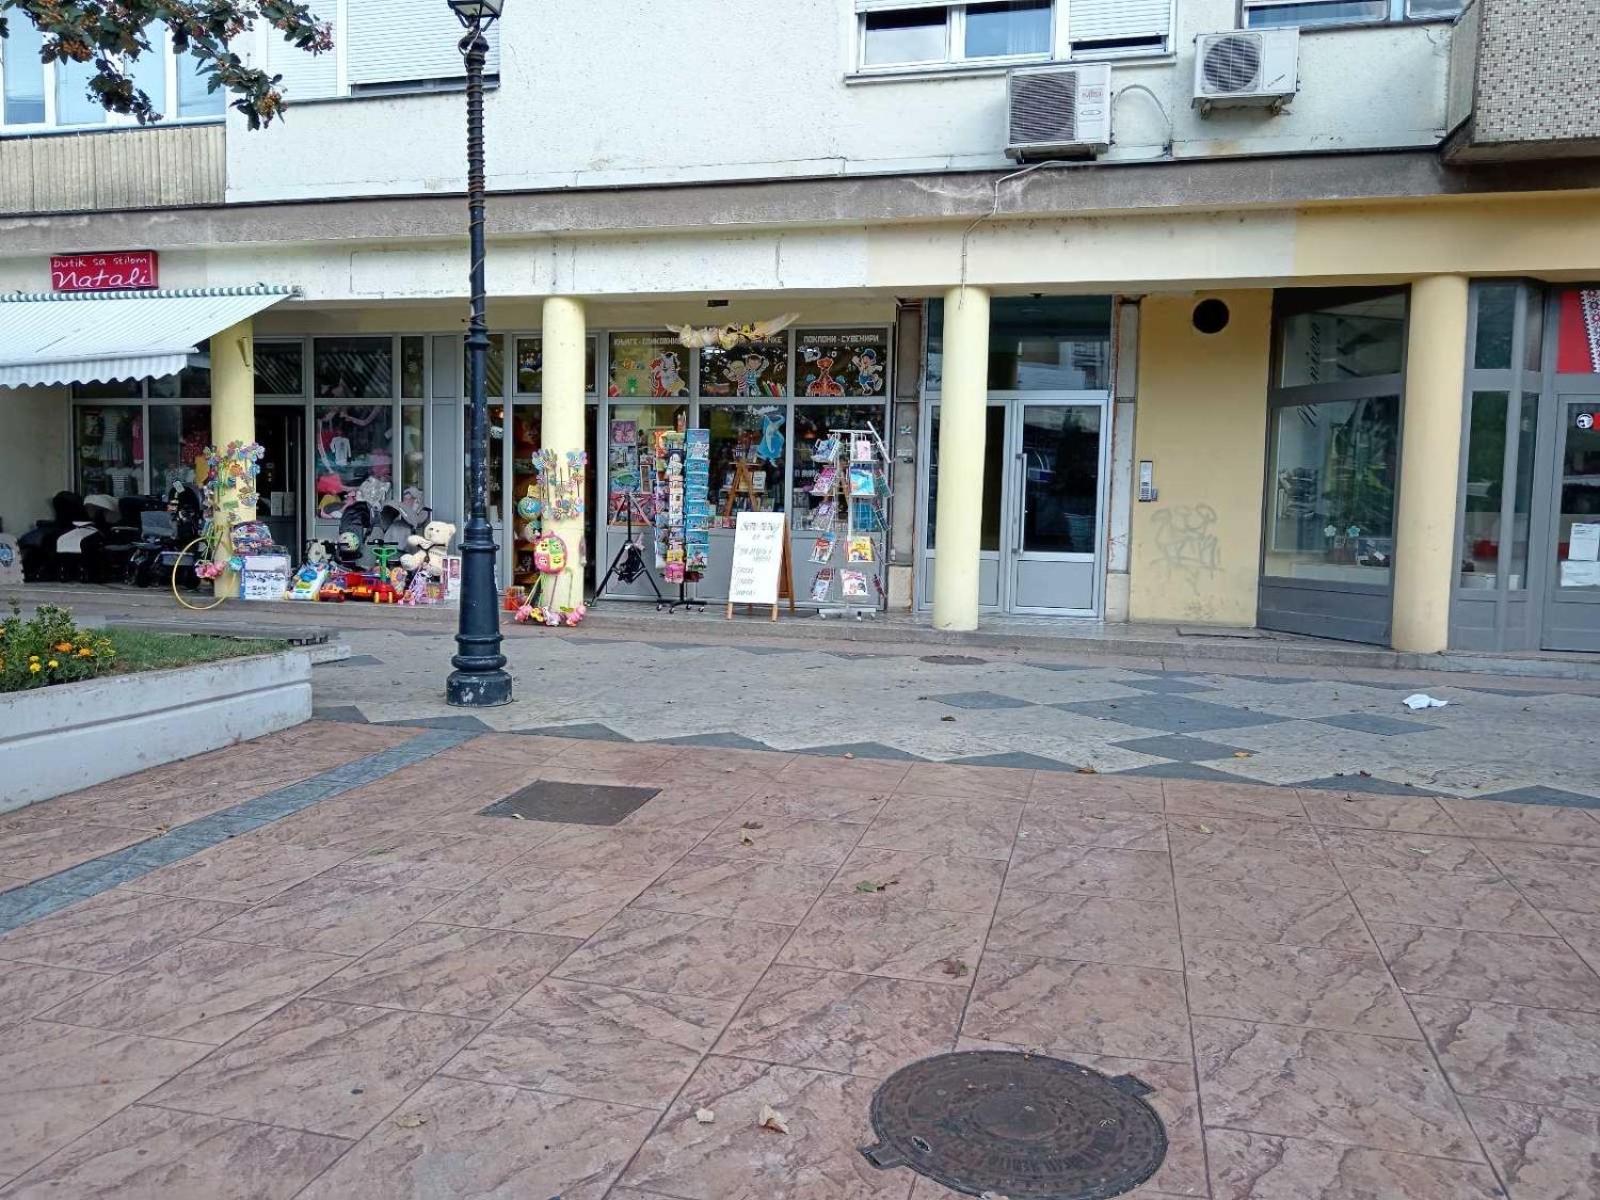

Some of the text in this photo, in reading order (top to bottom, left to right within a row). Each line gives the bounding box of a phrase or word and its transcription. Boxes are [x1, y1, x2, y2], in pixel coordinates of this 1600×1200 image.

[92, 257, 106, 266] sa
[803, 334, 880, 343] ПОКЛОНИ СУВЕНИРИ
